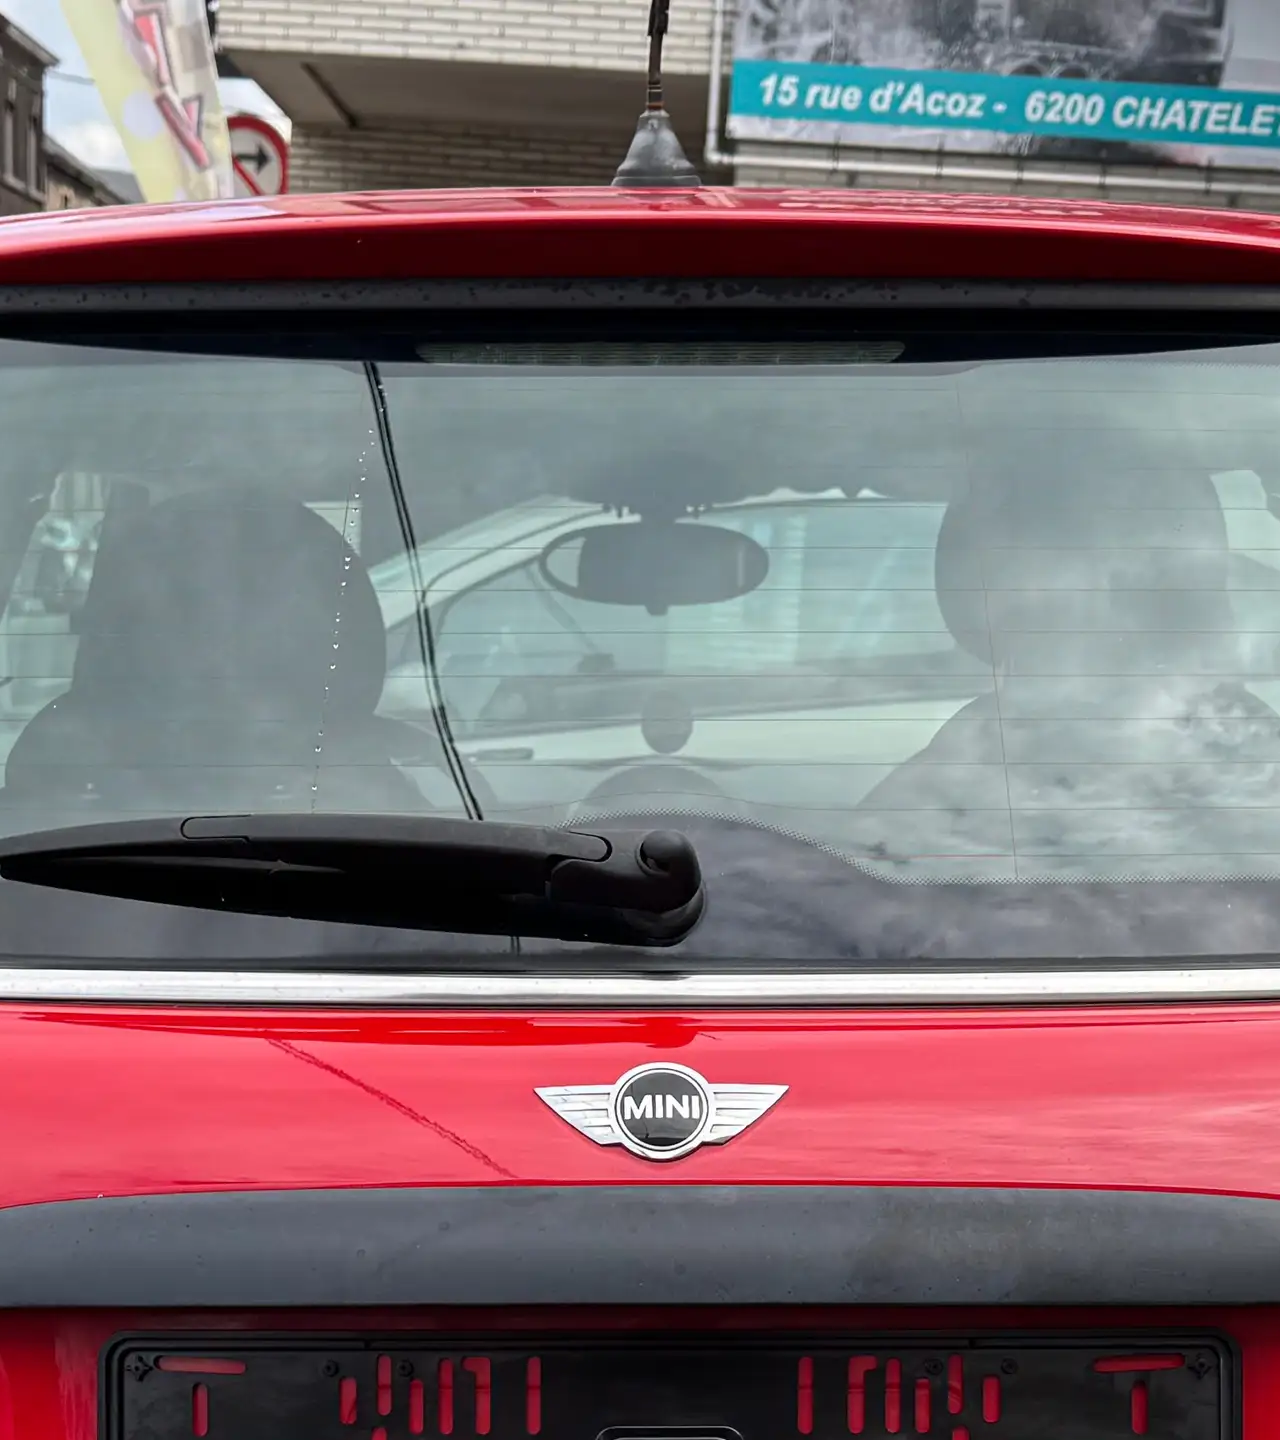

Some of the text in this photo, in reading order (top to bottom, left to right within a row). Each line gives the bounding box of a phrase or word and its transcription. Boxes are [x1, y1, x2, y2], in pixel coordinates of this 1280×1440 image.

[759, 73, 800, 107] 15
[805, 82, 863, 112] rue
[869, 80, 988, 119] d'Acoz
[1024, 89, 1106, 127] 6200
[623, 1093, 702, 1120] MINI
